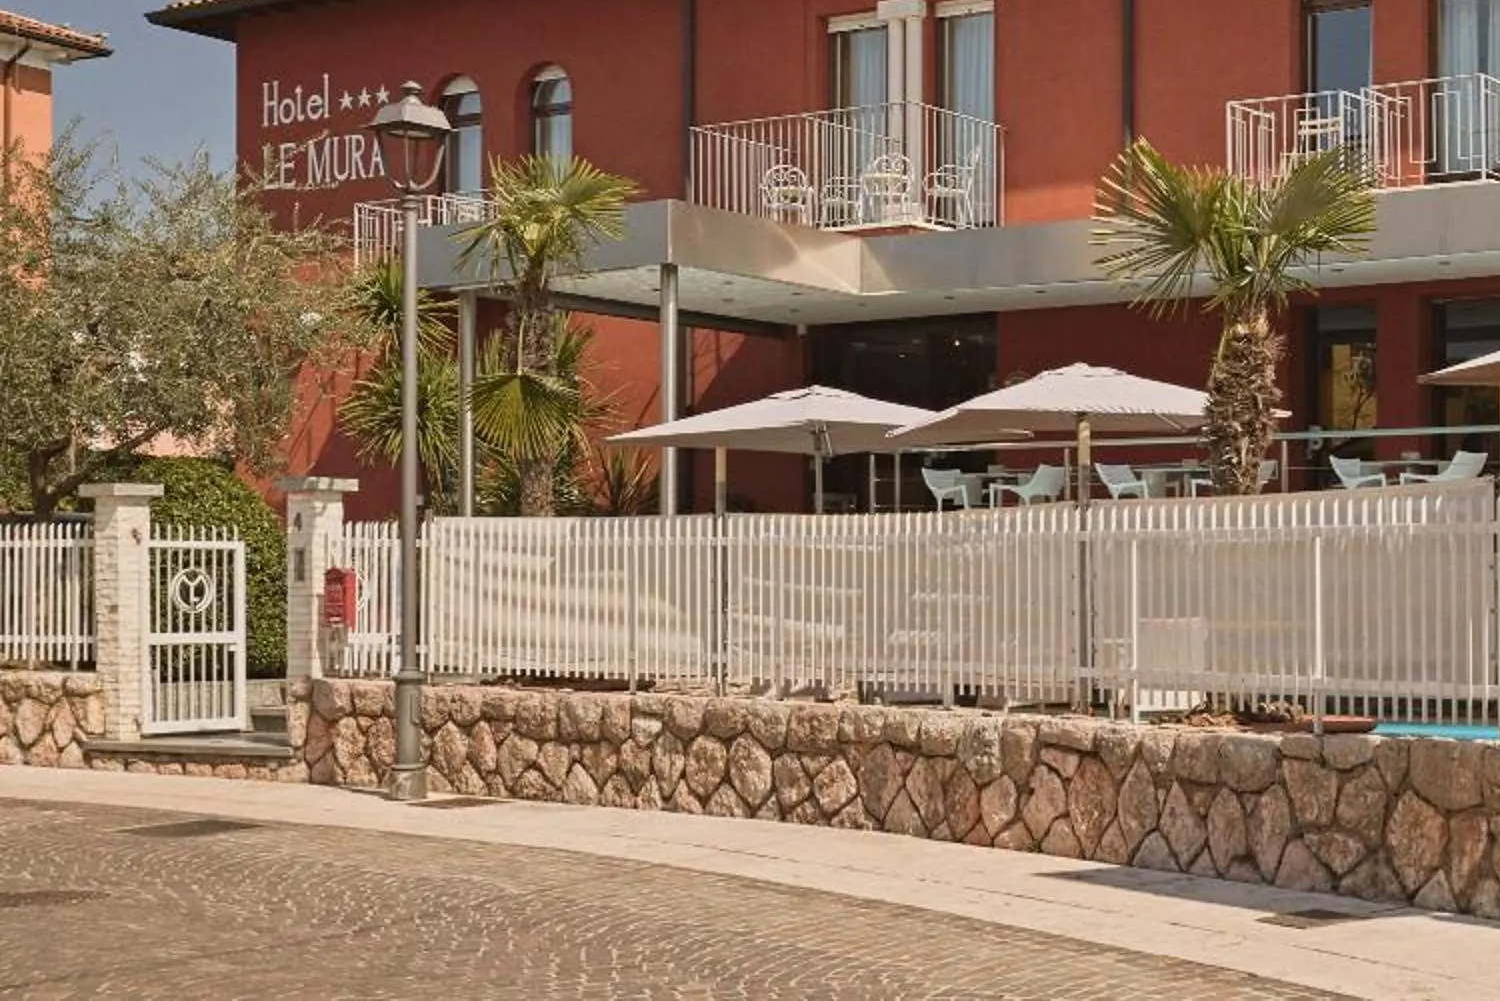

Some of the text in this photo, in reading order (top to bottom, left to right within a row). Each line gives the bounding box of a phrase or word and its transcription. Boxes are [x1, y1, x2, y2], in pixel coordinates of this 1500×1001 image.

[261, 72, 330, 128] Hotel
[262, 134, 385, 190] LE MURA
